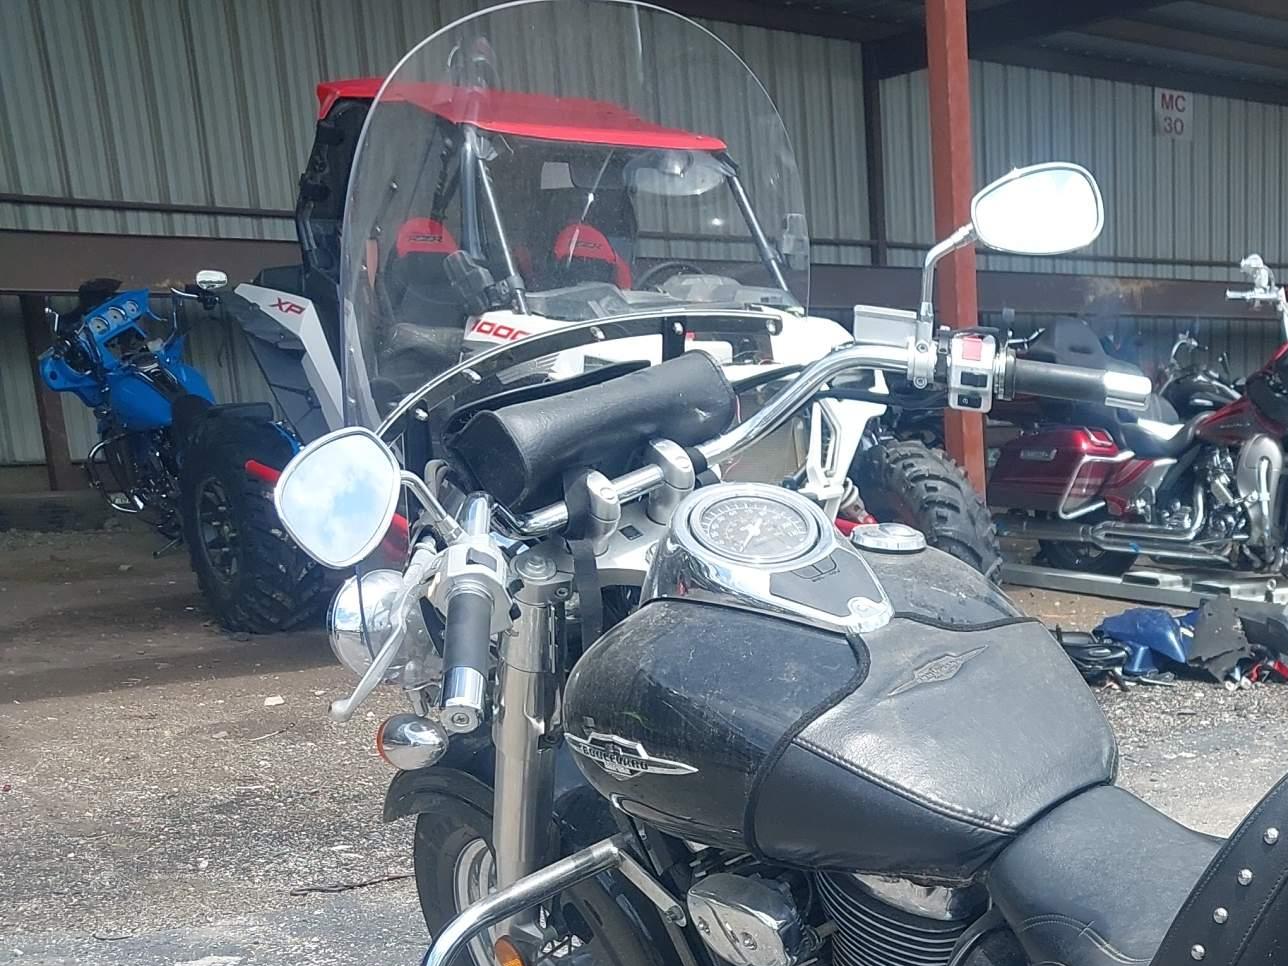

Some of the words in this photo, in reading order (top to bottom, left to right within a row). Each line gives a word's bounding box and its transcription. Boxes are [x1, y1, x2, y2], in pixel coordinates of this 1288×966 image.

[1161, 93, 1186, 112] MC
[1163, 116, 1184, 135] 30
[269, 297, 306, 315] XP
